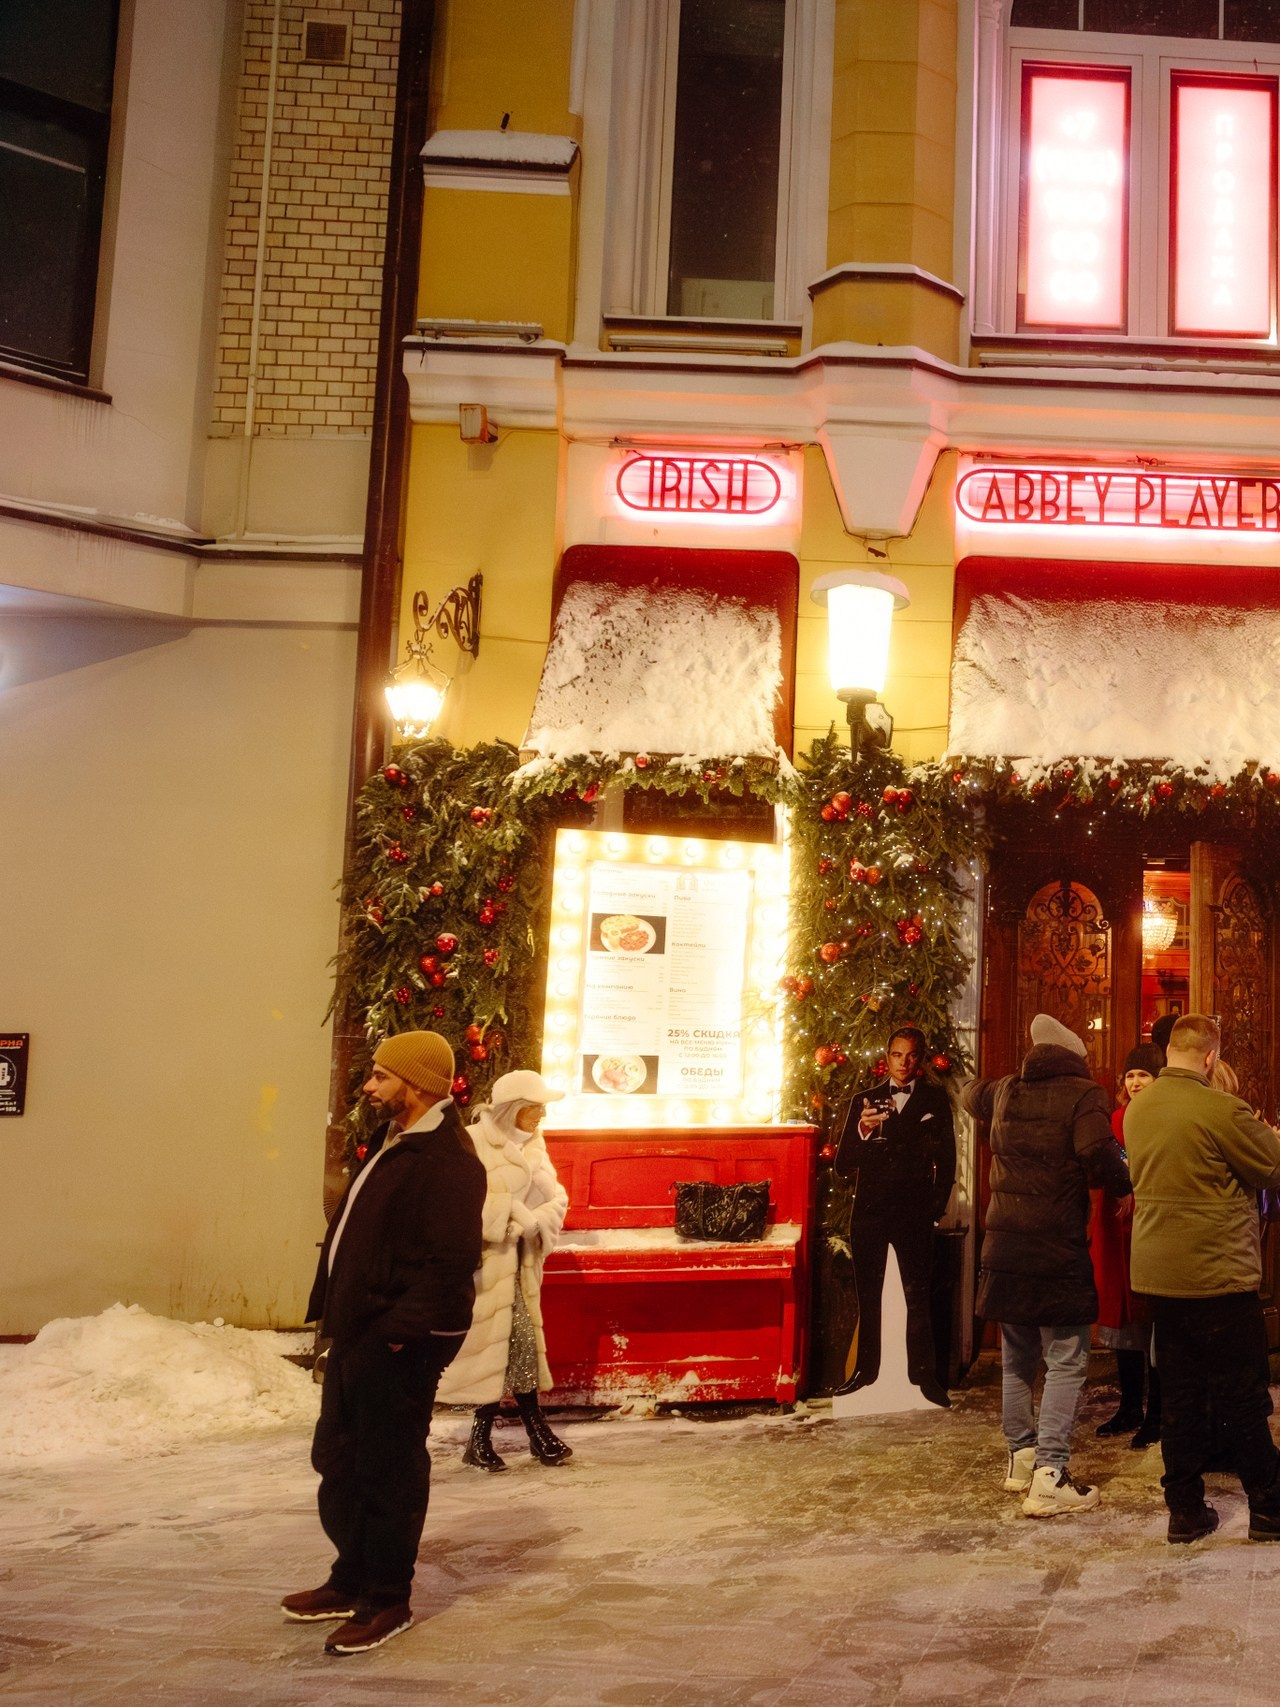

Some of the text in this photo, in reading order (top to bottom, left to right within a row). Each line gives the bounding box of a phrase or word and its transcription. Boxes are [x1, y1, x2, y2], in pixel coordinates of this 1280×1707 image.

[648, 458, 749, 512] IRISH
[981, 473, 1111, 526] ABBEY
[667, 1029, 689, 1038] 25%
[681, 1067, 724, 1077] ОБЕДЫ
